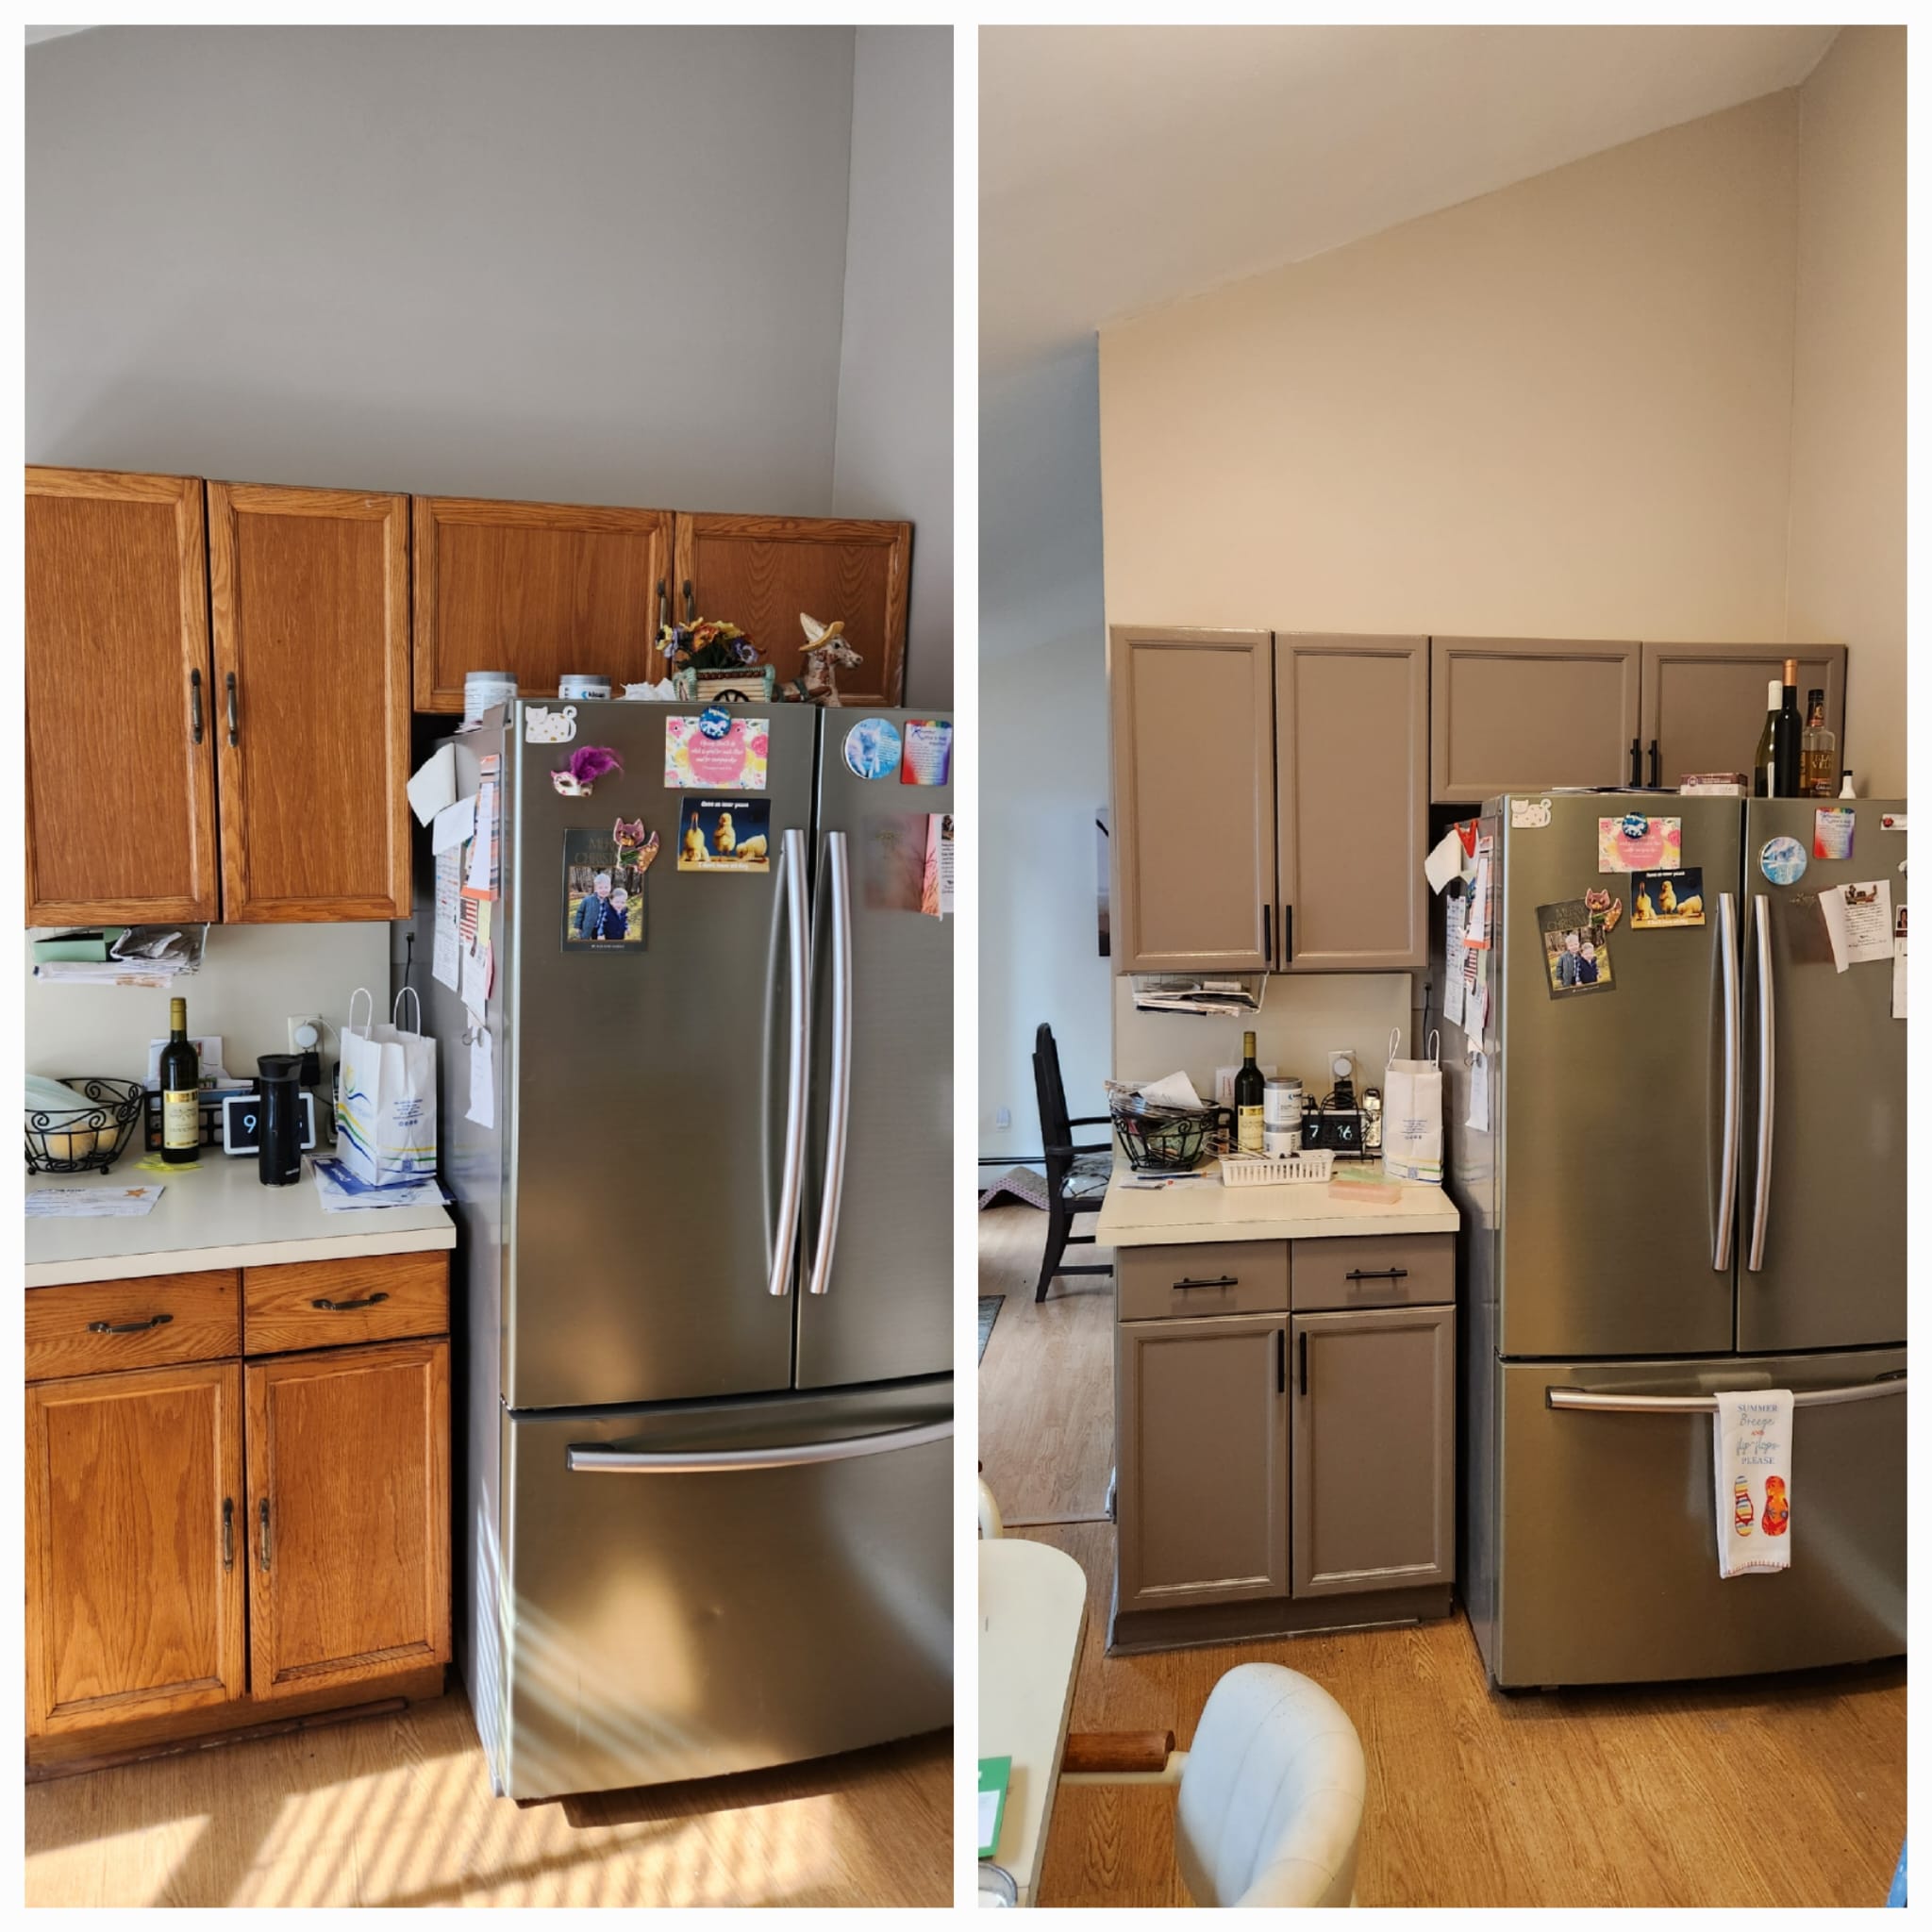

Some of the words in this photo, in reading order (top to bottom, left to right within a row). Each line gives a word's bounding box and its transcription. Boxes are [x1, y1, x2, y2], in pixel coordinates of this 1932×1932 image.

[243, 1115, 257, 1134] 9
[1308, 1124, 1320, 1140] 7
[1337, 1124, 1353, 1140] 16
[1737, 1403, 1778, 1412] SUMMER
[1741, 1456, 1775, 1465] PLEASE
